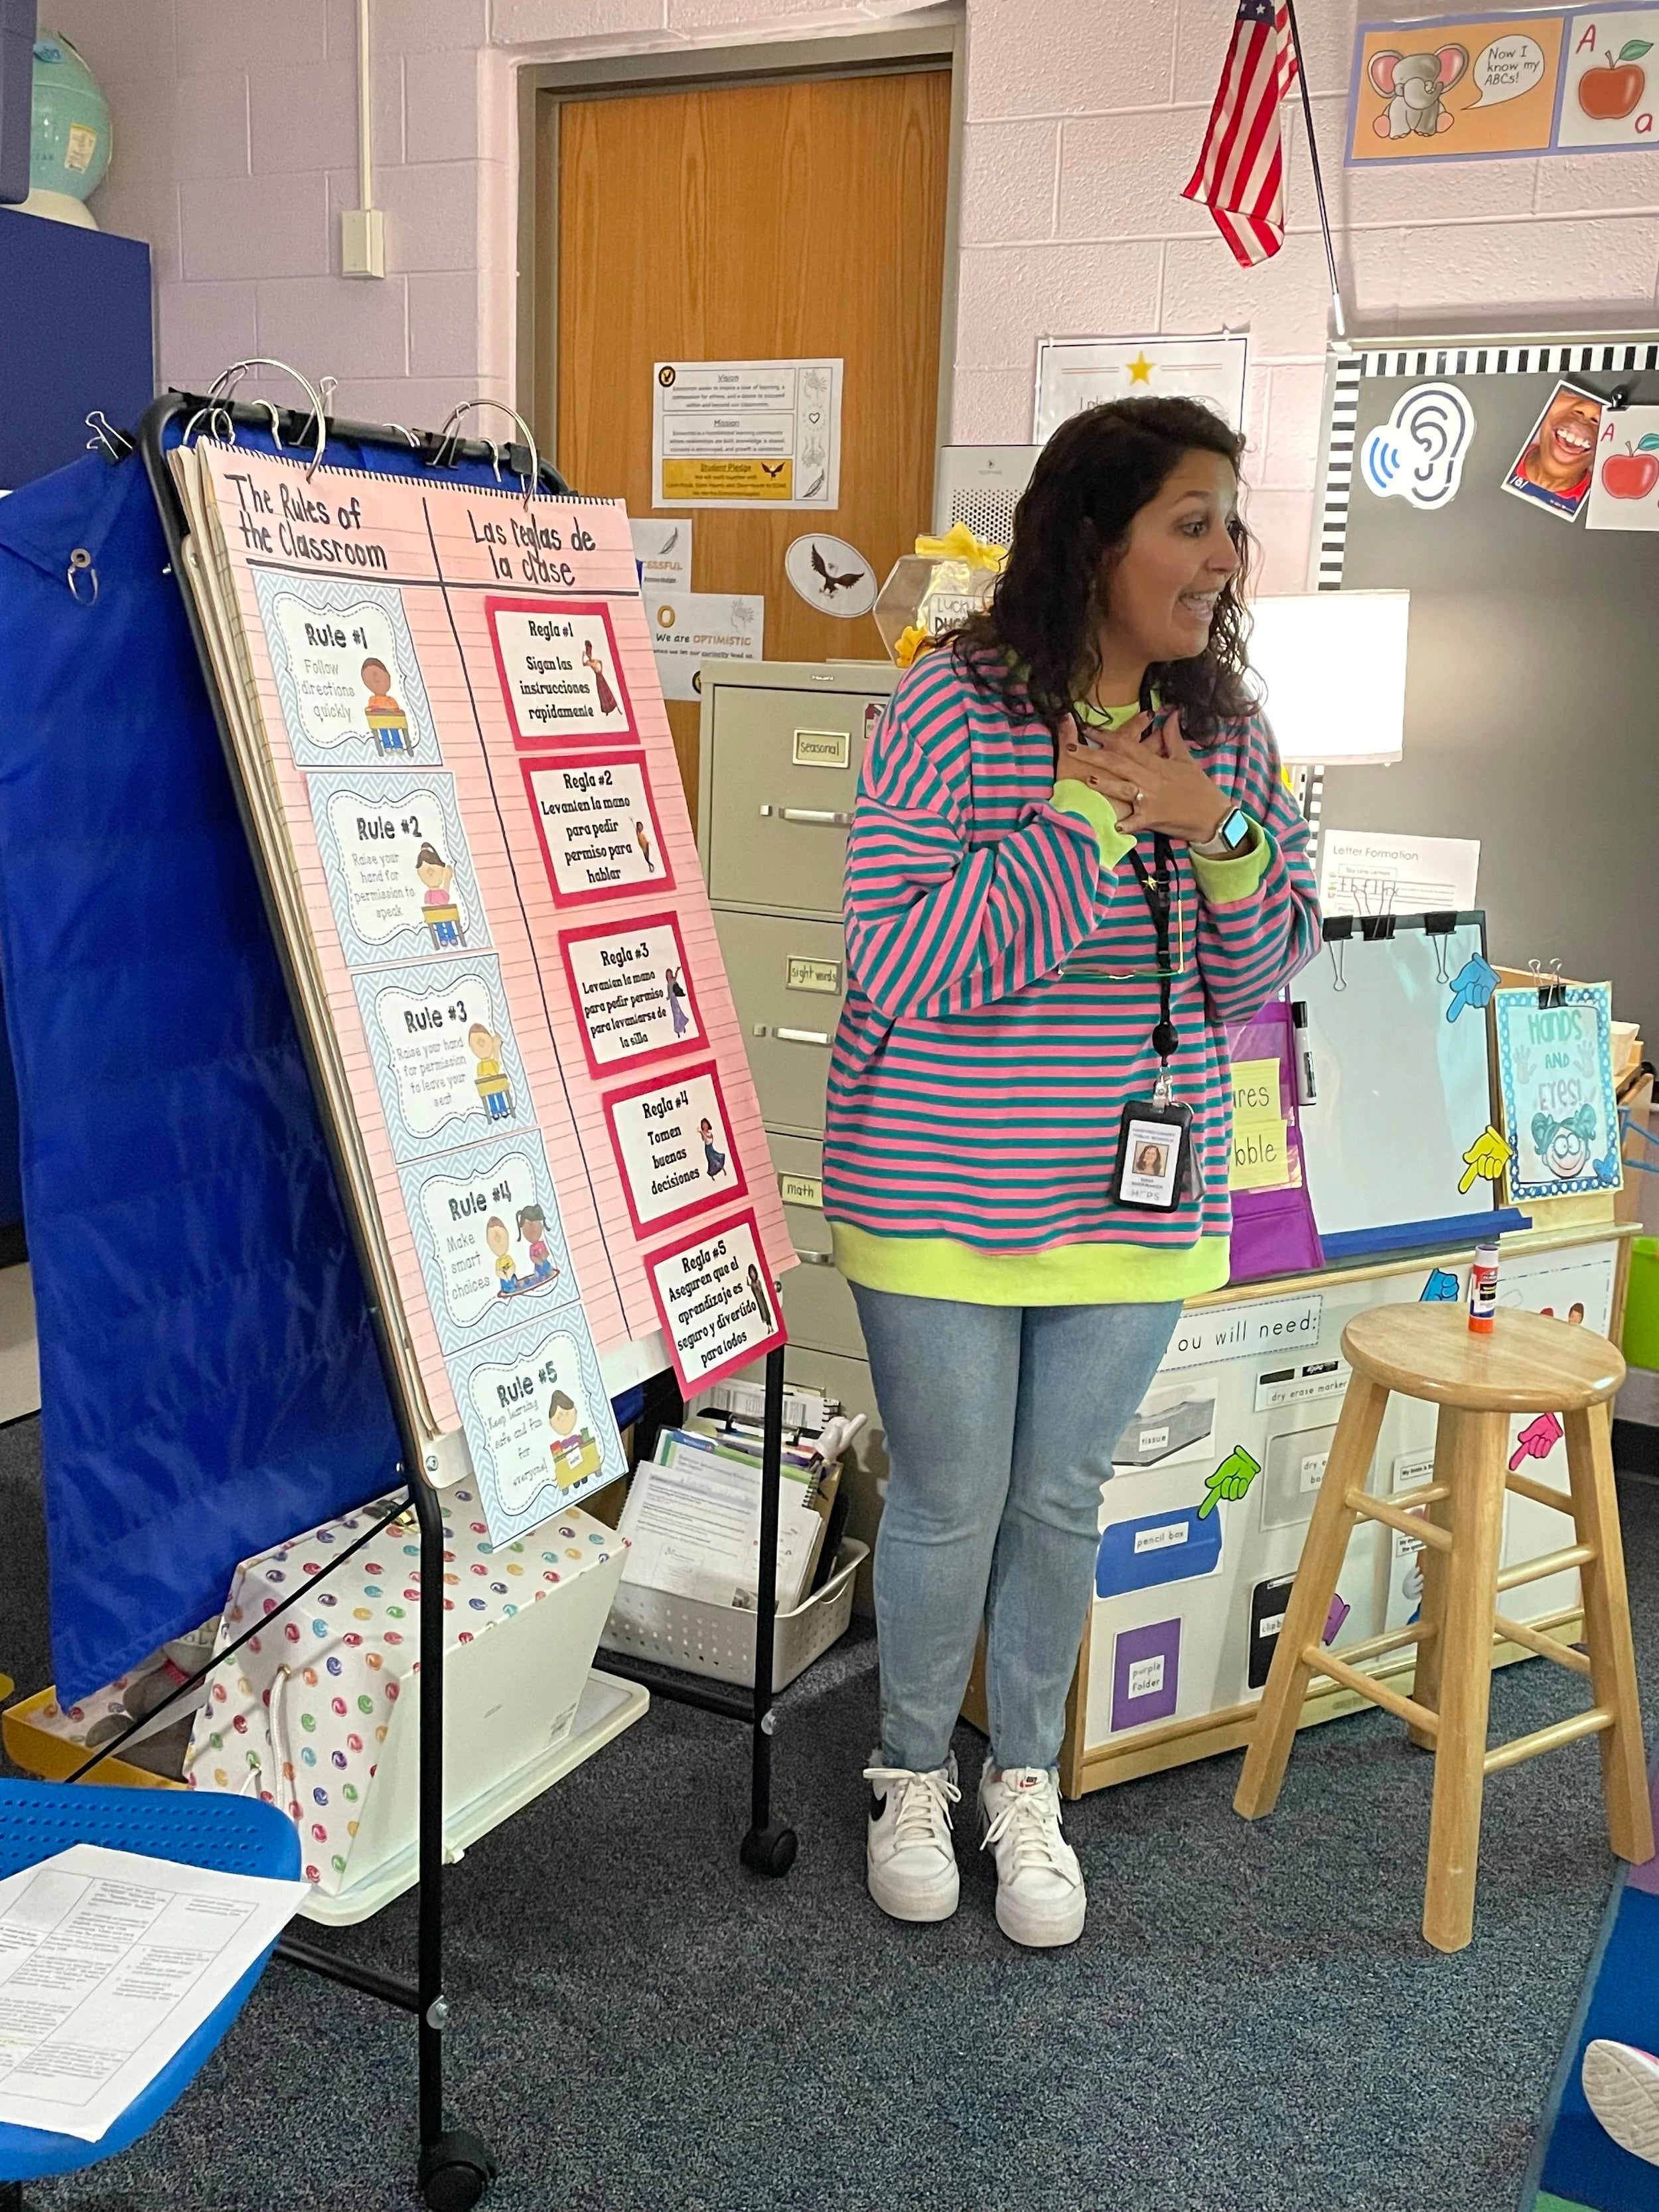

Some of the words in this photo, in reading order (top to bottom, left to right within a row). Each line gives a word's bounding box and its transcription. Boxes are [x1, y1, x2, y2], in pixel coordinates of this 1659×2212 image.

[1576, 24, 1596, 54] A
[1488, 47, 1516, 60] Now
[1487, 62, 1518, 72] know
[1523, 60, 1540, 72] my
[1484, 72, 1520, 86] ABCs!
[1634, 113, 1653, 133] a
[1601, 423, 1615, 441] A
[224, 473, 273, 514] The
[279, 482, 330, 525] Rules
[337, 496, 362, 531] of
[239, 510, 273, 554] the
[279, 520, 388, 570] Classroom
[467, 510, 507, 546] Las
[571, 517, 596, 551] de
[489, 546, 512, 579] la
[522, 551, 575, 585] clase
[657, 605, 676, 628] O
[305, 623, 347, 649] Rule
[352, 626, 368, 649] #1
[528, 621, 560, 641] Regla
[563, 623, 573, 637] #1
[656, 633, 671, 642] We
[693, 636, 751, 646] OPTIMISTIC
[304, 659, 339, 676] Follow
[526, 656, 556, 674] Sigan
[557, 656, 572, 670] las
[301, 676, 355, 698] directions
[520, 681, 590, 695] instrucciones
[313, 705, 352, 723] quickly
[563, 772, 596, 792] Regla
[598, 770, 613, 786] #2
[541, 800, 591, 815] Levanten
[591, 796, 601, 810] la
[603, 797, 630, 808] mano
[356, 816, 395, 840] Rule
[400, 816, 422, 838] #2
[566, 825, 591, 841] para
[592, 818, 618, 838] pedir
[352, 853, 378, 865] Raise
[380, 853, 399, 867] your
[565, 844, 607, 865] permiso
[609, 844, 632, 860] para
[1333, 846, 1363, 856] Letter
[1365, 848, 1419, 861] Formation
[361, 871, 384, 883] hand
[385, 871, 399, 881] for
[586, 867, 620, 883] hablar
[354, 887, 403, 905] permission
[405, 886, 415, 897] to
[376, 907, 403, 921] speak
[601, 947, 633, 968] Regla
[635, 942, 649, 958] #3
[582, 978, 622, 994] Levanten
[622, 974, 632, 986] la
[633, 970, 655, 983] mano
[585, 1001, 605, 1019] para
[607, 995, 628, 1013] pedir
[630, 988, 664, 1007] permiso
[403, 1007, 443, 1033] Rule
[448, 1000, 467, 1022] #3
[591, 1021, 611, 1038] para
[612, 1012, 656, 1029] levantarse
[658, 1006, 666, 1017] de
[397, 1045, 421, 1060] Raise
[423, 1043, 442, 1059] your
[442, 1036, 464, 1051] hand
[619, 1037, 630, 1048] la
[630, 1032, 648, 1045] silla
[403, 1065, 417, 1076] for
[419, 1055, 467, 1076] permission
[1545, 1052, 1569, 1069] AND
[411, 1082, 421, 1094] to
[422, 1078, 445, 1091] leave
[447, 1073, 466, 1088] your
[434, 1093, 452, 1107] seat
[642, 1098, 674, 1118] Regla
[675, 1090, 689, 1108] #4
[648, 1126, 682, 1145] Tomen
[652, 1148, 687, 1169] buenas
[652, 1168, 700, 1195] decisiones
[787, 1183, 814, 1199] math
[448, 1191, 487, 1221] Rule
[492, 1181, 512, 1203] #4
[447, 1233, 475, 1252] Make
[451, 1252, 481, 1274] smart
[682, 1249, 711, 1274] Regla
[712, 1240, 726, 1259] #5
[452, 1276, 490, 1300] choices
[669, 1273, 712, 1302] Aseguren
[713, 1266, 730, 1283] que
[731, 1256, 739, 1271] el
[678, 1286, 733, 1325] aprendizaje
[733, 1283, 743, 1294] es
[678, 1327, 709, 1351] seguro
[710, 1323, 715, 1337] y
[717, 1299, 757, 1330] divertido
[1165, 1337, 1202, 1354] ou
[1216, 1320, 1247, 1345] will
[1259, 1309, 1317, 1338] need:
[701, 1347, 723, 1368] para
[723, 1331, 747, 1352] todos
[496, 1376, 534, 1408] Rule
[538, 1361, 557, 1384] #5
[1272, 1392, 1285, 1402] dry
[1291, 1388, 1313, 1398] erase
[1141, 1434, 1167, 1445] tissue
[1304, 1461, 1317, 1470] dry
[1137, 1533, 1165, 1549] pencil
[1168, 1530, 1184, 1541] box
[1133, 1662, 1161, 1679] purple
[1133, 1678, 1161, 1692] folder
